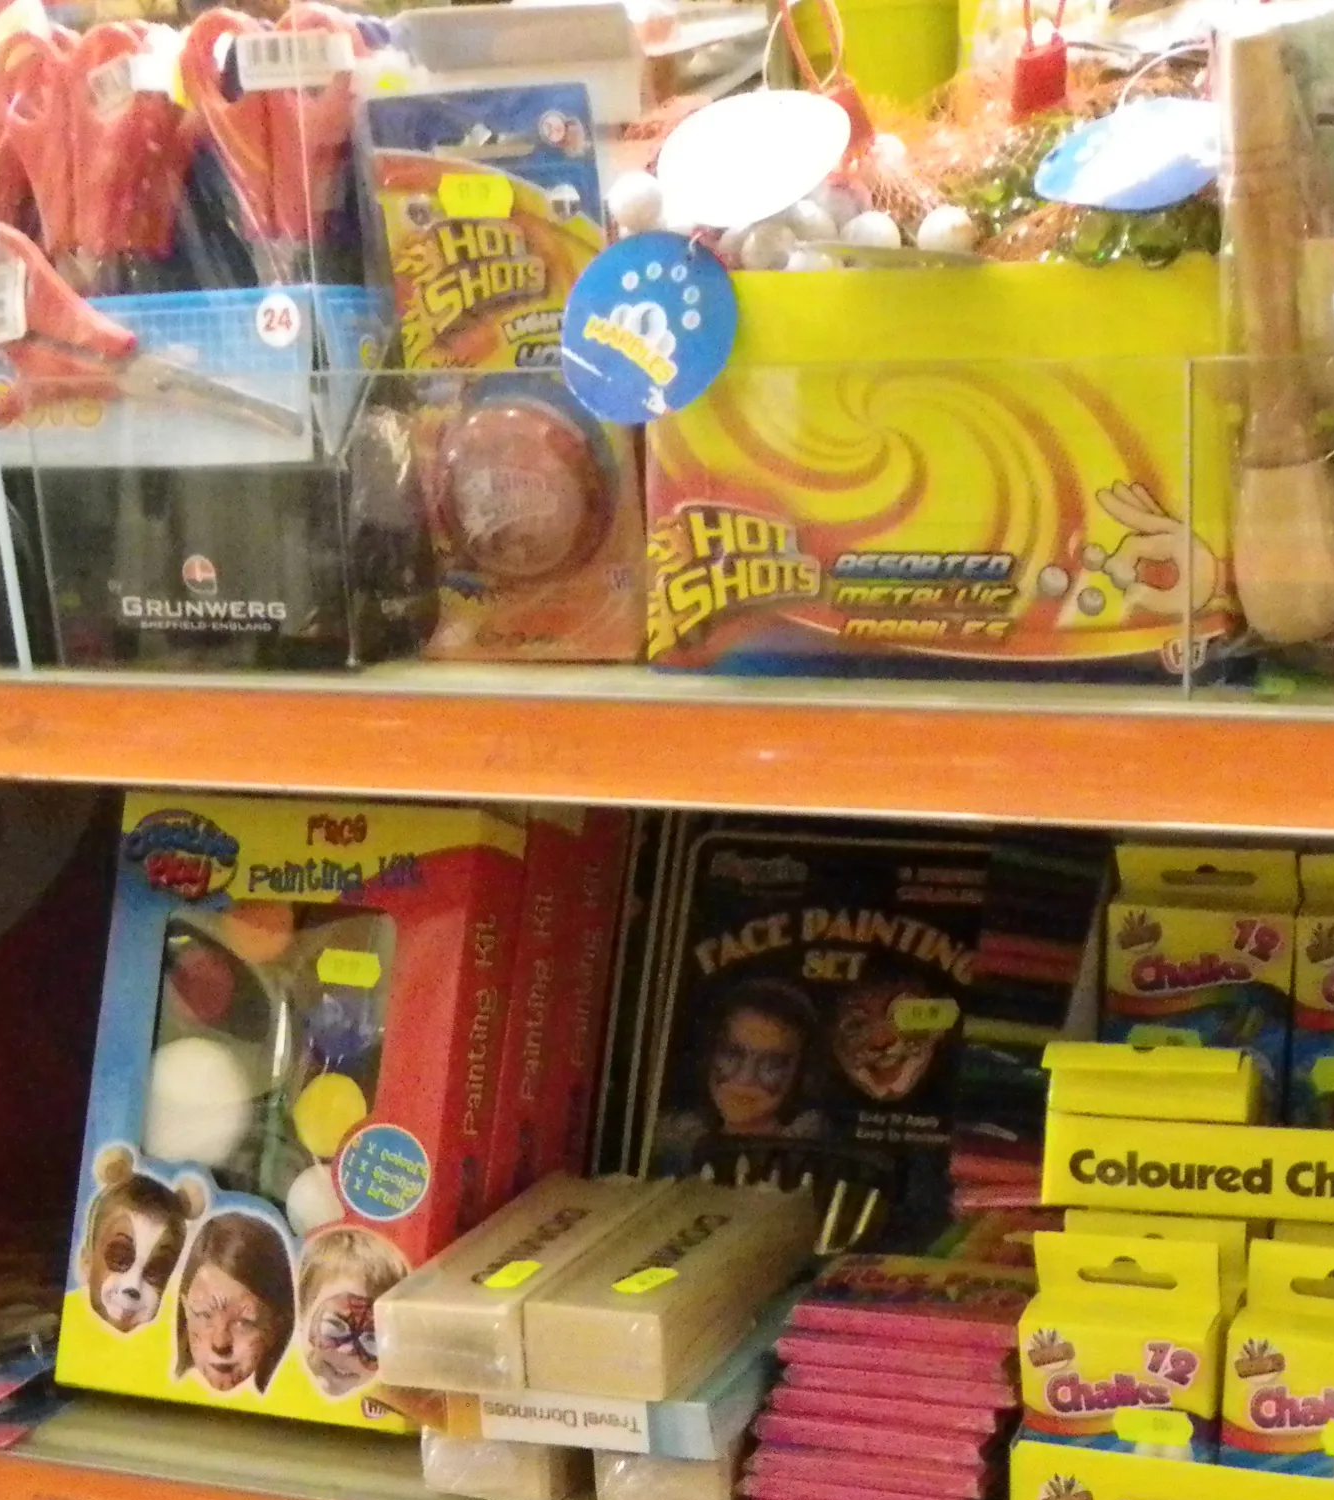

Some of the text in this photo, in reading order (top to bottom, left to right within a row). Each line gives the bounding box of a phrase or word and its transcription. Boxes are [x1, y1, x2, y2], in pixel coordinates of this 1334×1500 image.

[437, 221, 525, 266] HOT
[424, 257, 545, 333] SHOTS
[261, 307, 294, 333] 24
[687, 510, 795, 558] HOT
[833, 553, 1012, 580] ASSORTED
[121, 595, 288, 621] GRUNWERG
[669, 556, 817, 638] SHOTS
[248, 857, 364, 895] Painting
[696, 907, 977, 986] FACE PAINTING
[1233, 917, 1284, 963] 12
[803, 950, 866, 981] SET
[1130, 952, 1255, 994] Chalks
[520, 883, 556, 1102] Painting Kit
[463, 912, 498, 1138] Painting Kit
[1068, 1147, 1274, 1196] Coloured
[1147, 1341, 1200, 1387] 12
[1044, 1371, 1171, 1415] Chalks
[482, 1399, 644, 1435] Travel Dominoes
